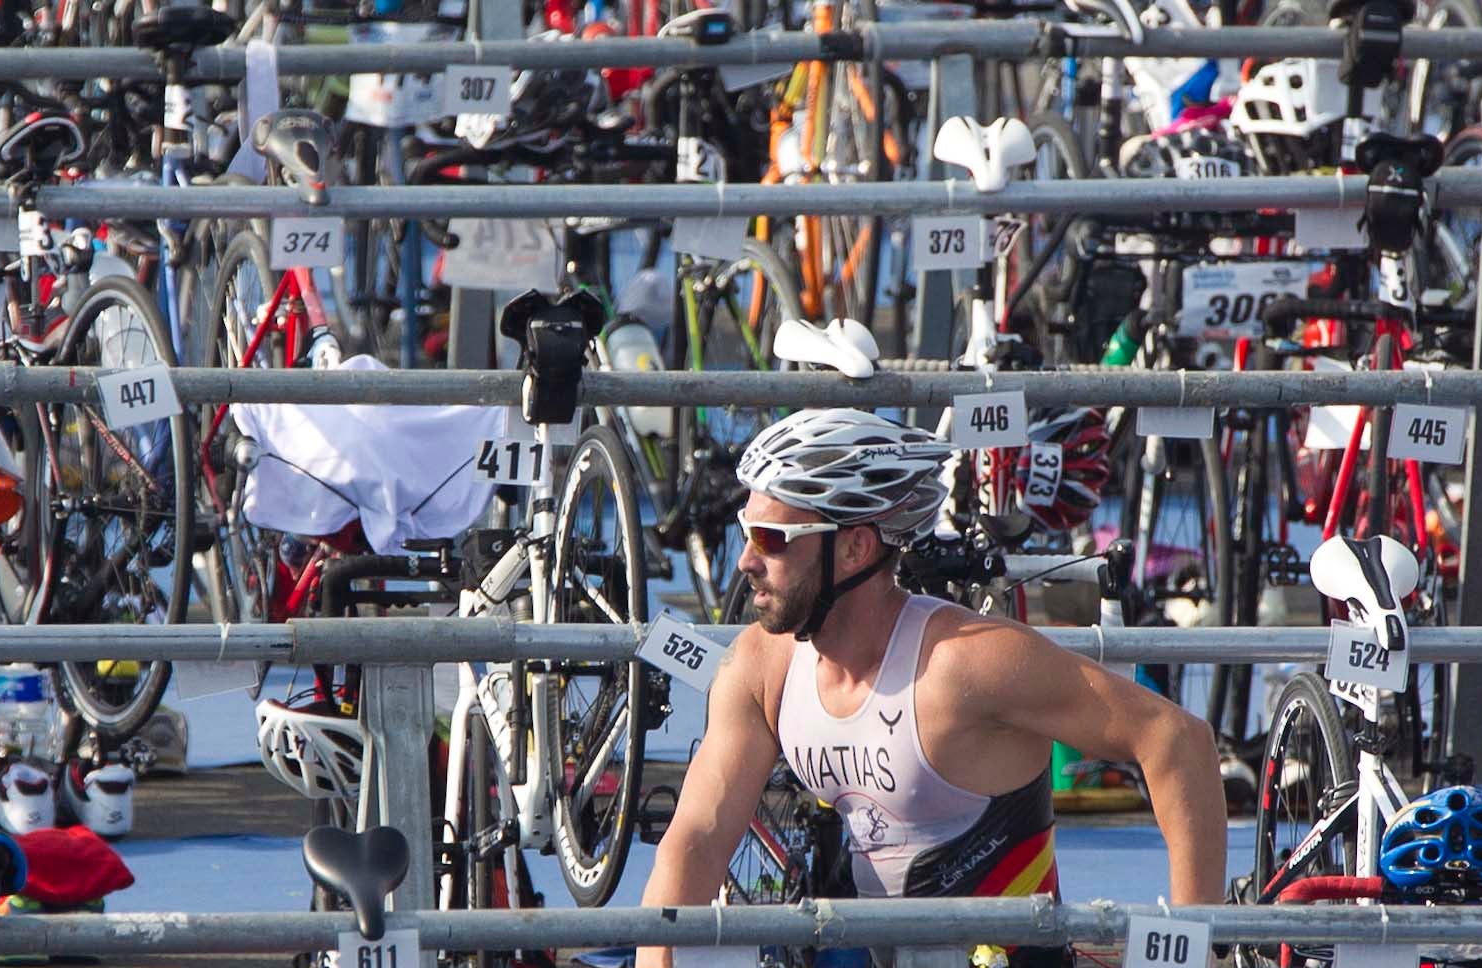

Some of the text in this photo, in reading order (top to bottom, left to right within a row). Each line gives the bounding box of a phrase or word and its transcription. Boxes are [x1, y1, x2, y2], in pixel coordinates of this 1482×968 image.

[460, 76, 496, 102] 307
[283, 231, 331, 254] 374
[929, 228, 966, 255] 373
[120, 378, 155, 409] 447
[970, 405, 1009, 433] 446
[1408, 417, 1447, 447] 445
[476, 440, 544, 481] 411
[1029, 452, 1059, 498] 373
[663, 632, 708, 670] 525
[1348, 641, 1389, 672] 524
[794, 745, 897, 793] MATIAS
[1145, 931, 1189, 965] 610
